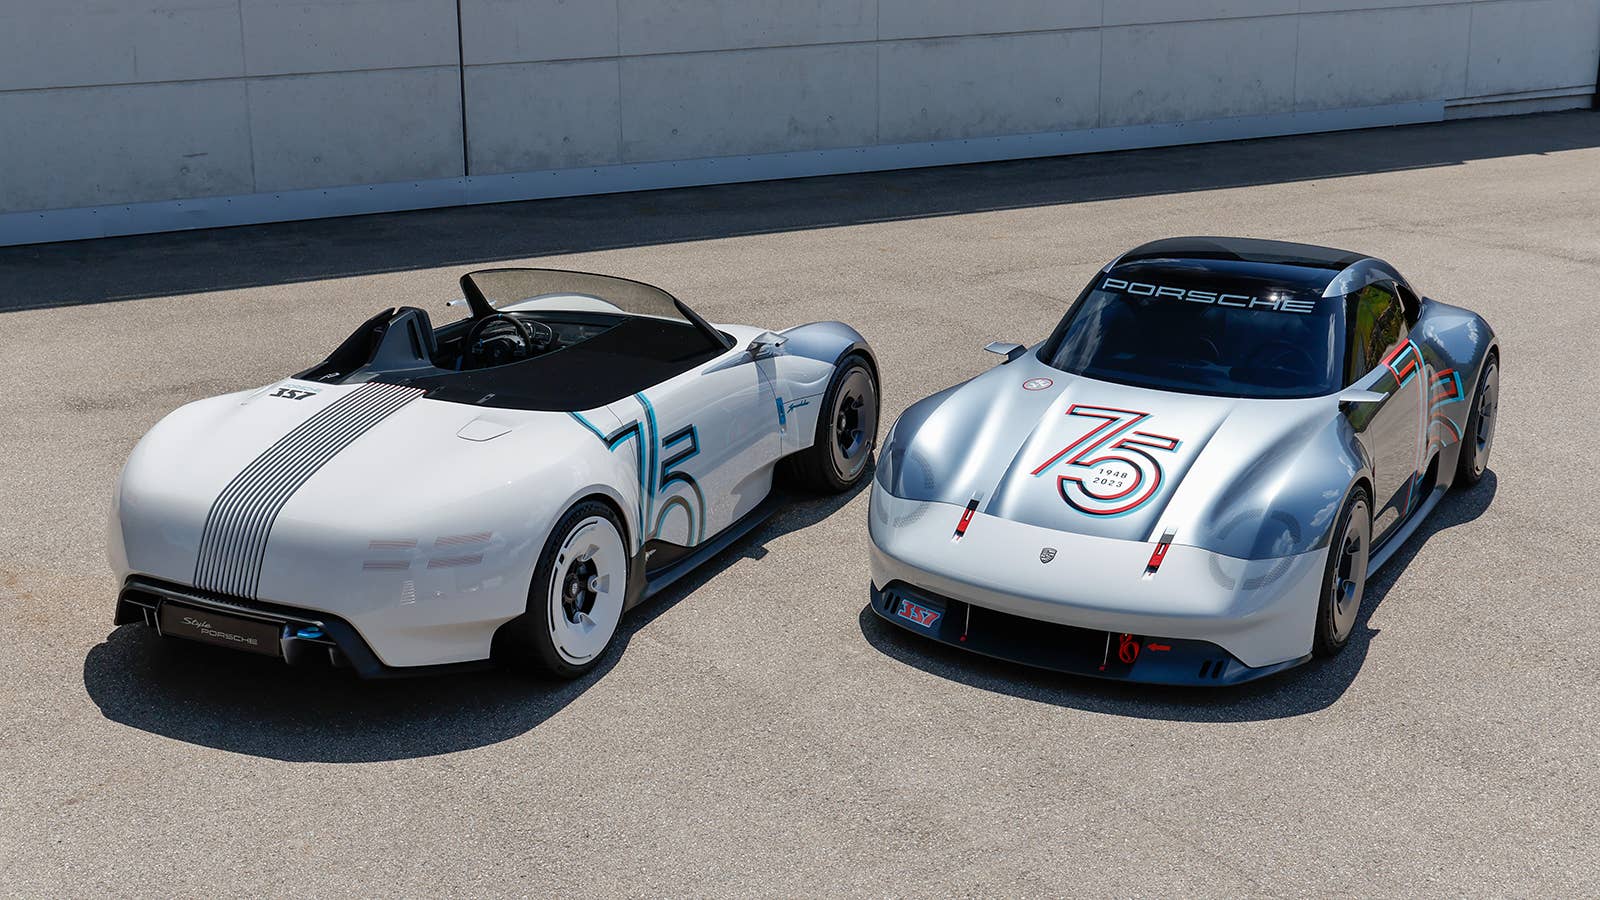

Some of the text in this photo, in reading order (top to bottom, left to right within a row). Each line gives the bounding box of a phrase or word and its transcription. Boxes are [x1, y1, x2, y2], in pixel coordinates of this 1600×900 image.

[1102, 277, 1316, 313] PORSCHE
[269, 387, 317, 401] 357
[567, 391, 707, 548] 75
[1030, 403, 1184, 519] 75
[1092, 476, 1123, 488] 2023
[1099, 468, 1128, 479] 1948
[897, 598, 941, 628] 357
[183, 616, 212, 629] Style
[201, 628, 258, 645] PORSCHE
